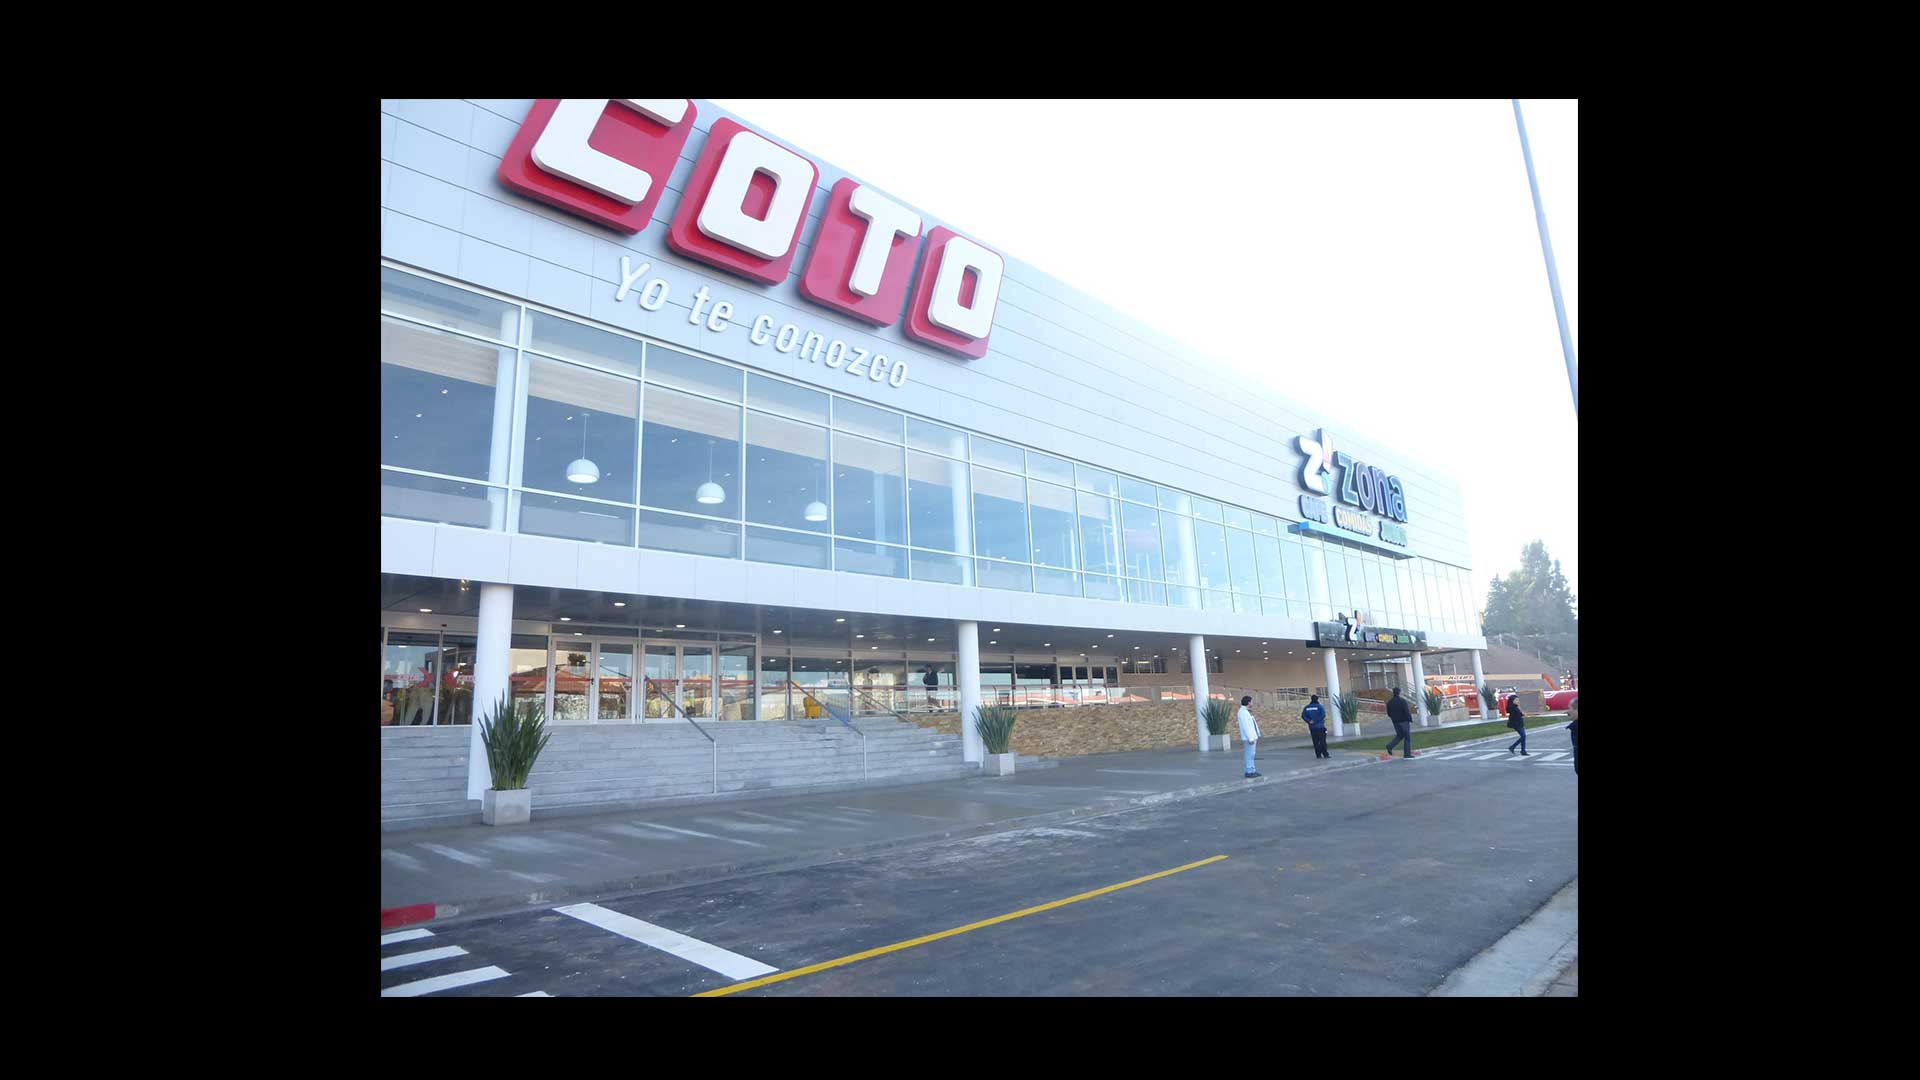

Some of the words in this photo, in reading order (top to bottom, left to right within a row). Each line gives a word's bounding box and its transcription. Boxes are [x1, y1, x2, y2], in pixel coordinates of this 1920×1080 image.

[531, 99, 1005, 340] COTO
[615, 256, 670, 312] Yo
[689, 286, 734, 333] te
[750, 314, 909, 389] conozco
[1332, 450, 1408, 523] zona
